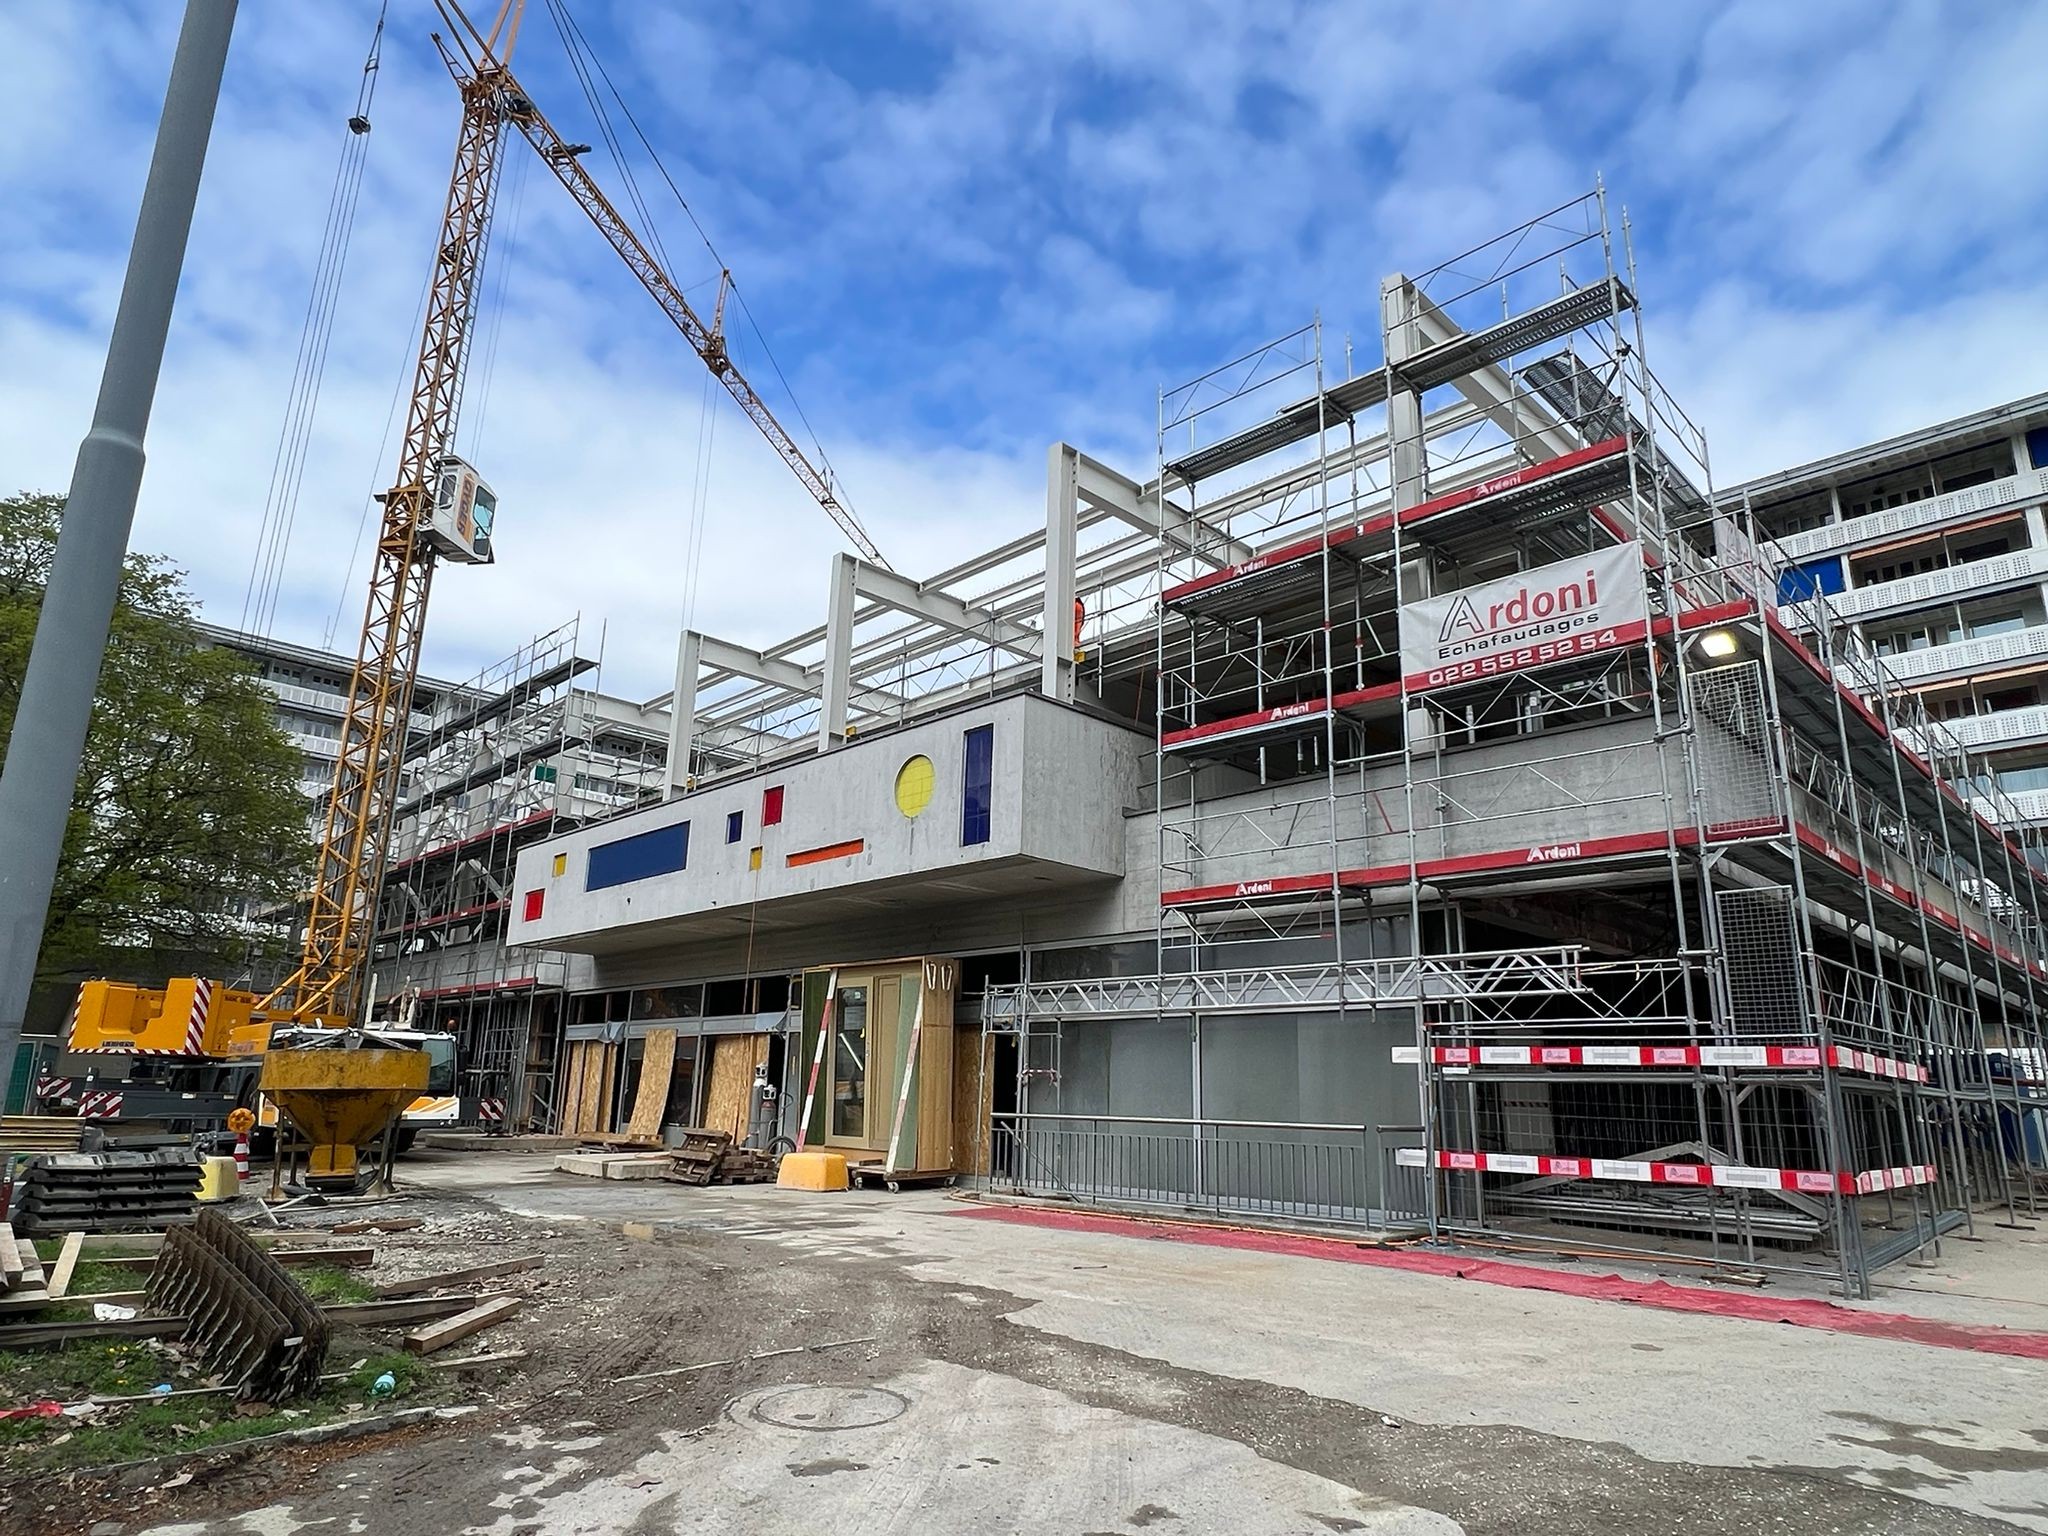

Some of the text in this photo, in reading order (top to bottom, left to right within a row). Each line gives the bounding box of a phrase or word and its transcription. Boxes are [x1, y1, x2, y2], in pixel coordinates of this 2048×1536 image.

[1475, 473, 1521, 497] Ardoni
[1439, 570, 1598, 643] Ardoni
[1439, 614, 1599, 659] Echafaudages
[1429, 629, 1617, 685] 022 552 52 54
[1270, 702, 1309, 720] Ardoni
[1527, 843, 1580, 862] Ardoni
[1235, 881, 1272, 896] Ardoni
